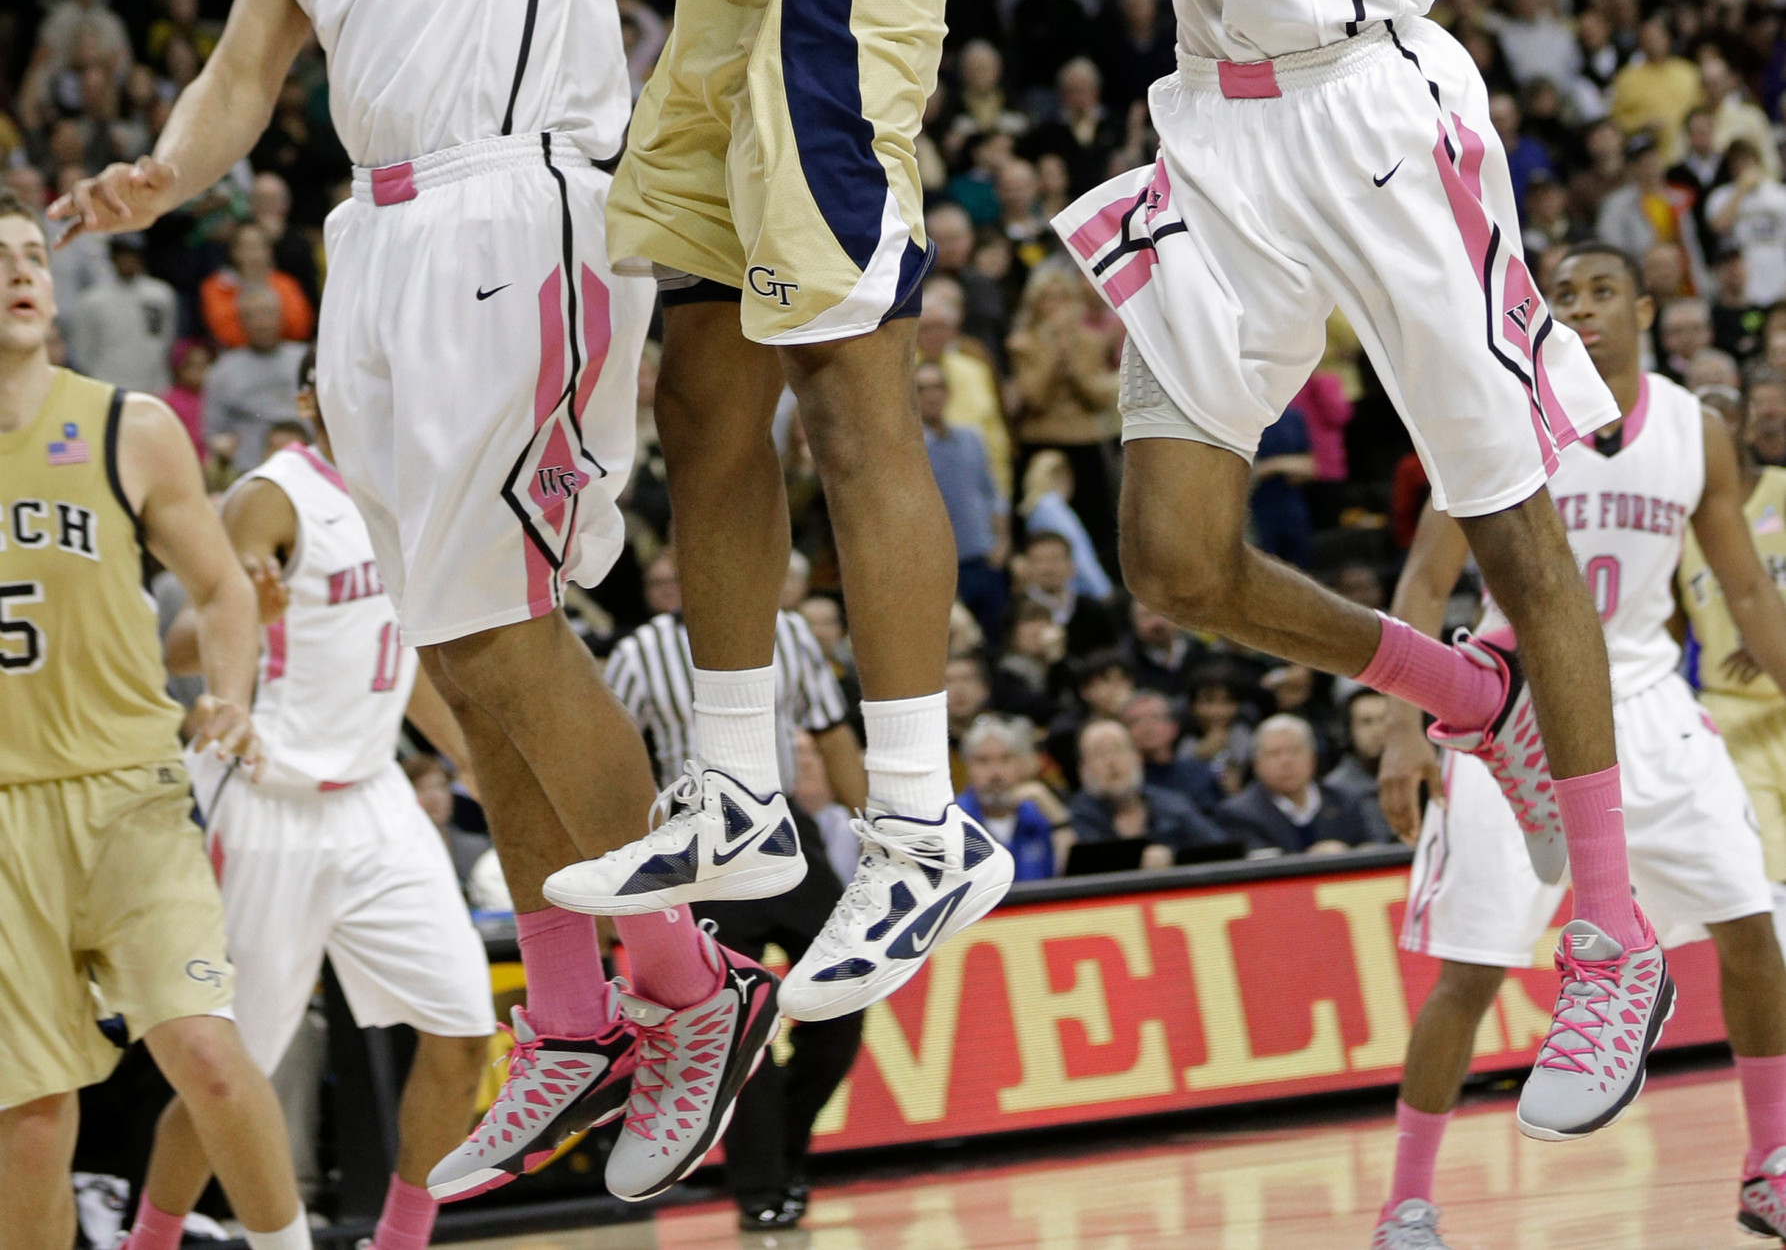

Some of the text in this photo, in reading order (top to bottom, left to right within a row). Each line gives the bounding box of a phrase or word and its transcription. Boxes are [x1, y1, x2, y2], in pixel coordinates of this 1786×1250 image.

[748, 265, 799, 306] GT
[537, 466, 579, 500] WF
[0, 500, 100, 561] CH
